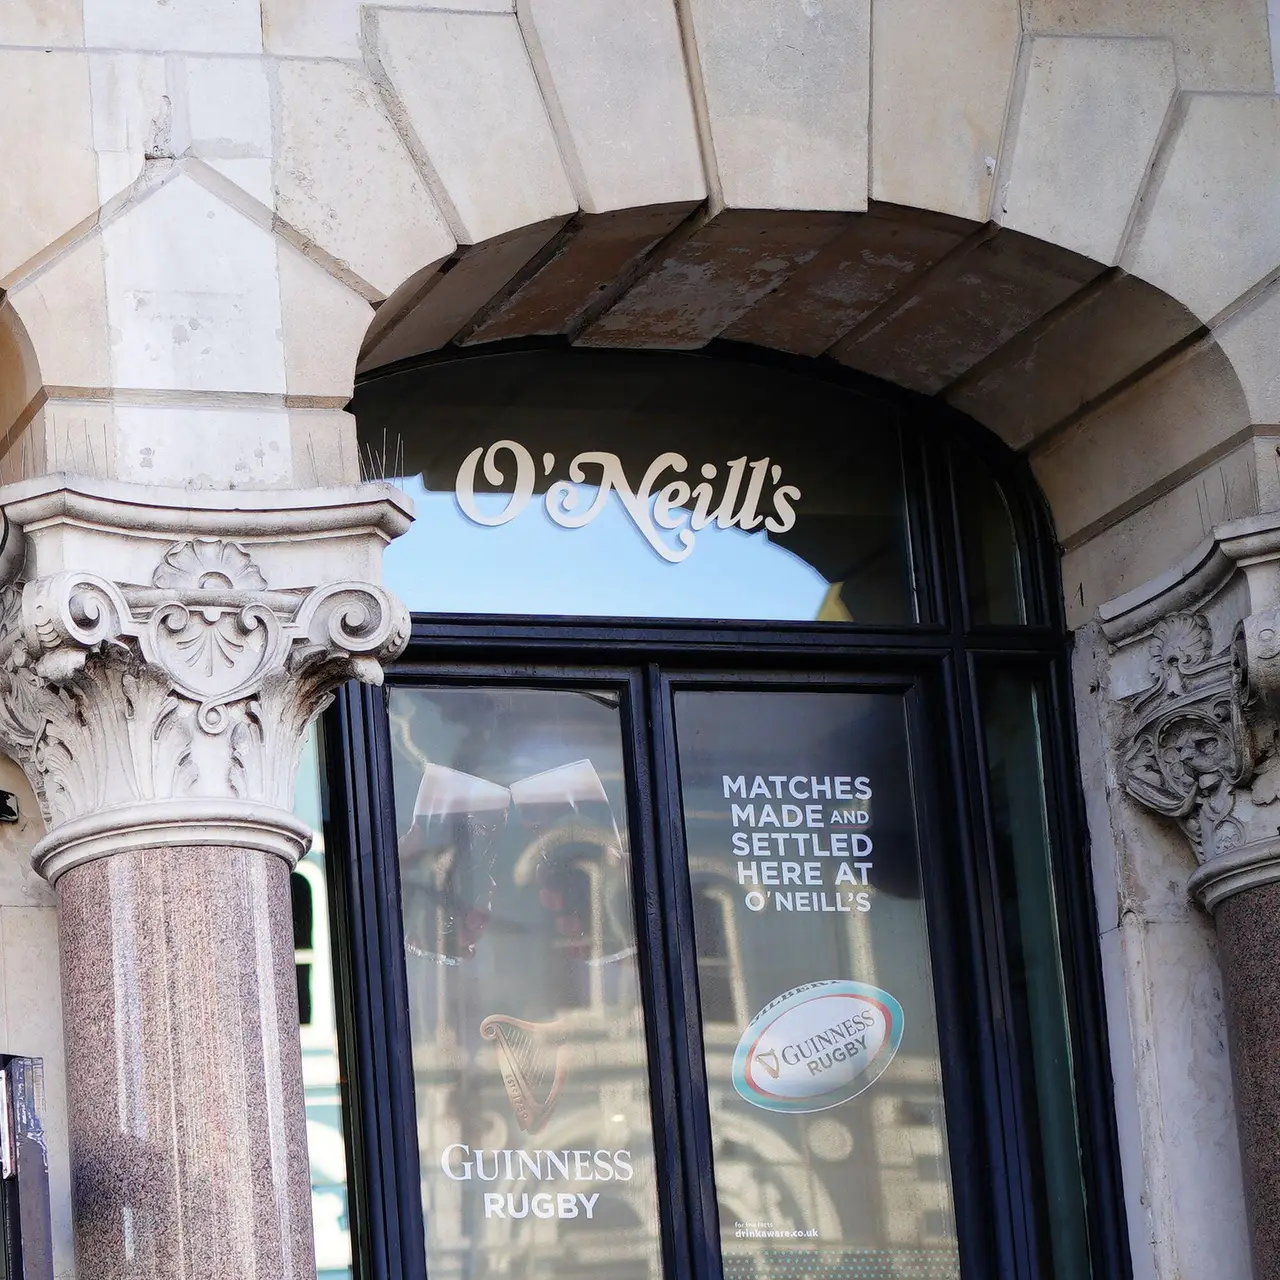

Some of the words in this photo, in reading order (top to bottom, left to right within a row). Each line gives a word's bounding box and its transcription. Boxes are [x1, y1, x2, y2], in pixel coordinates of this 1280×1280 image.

[455, 439, 802, 563] O'Neill's
[722, 775, 873, 800] MATCHES
[731, 804, 825, 828] MADE
[830, 810, 870, 824] AND
[731, 832, 873, 857] SETTLED
[737, 861, 824, 886] HERE
[835, 861, 873, 886] AT
[745, 891, 871, 912] O'NEILL'S
[781, 1010, 876, 1066] GUINNESS
[806, 1034, 869, 1077] RUGBY
[441, 1143, 634, 1181] GUINNESS
[484, 1193, 600, 1219] RUGBY
[735, 1228, 818, 1238] drinkaware.co.uk
